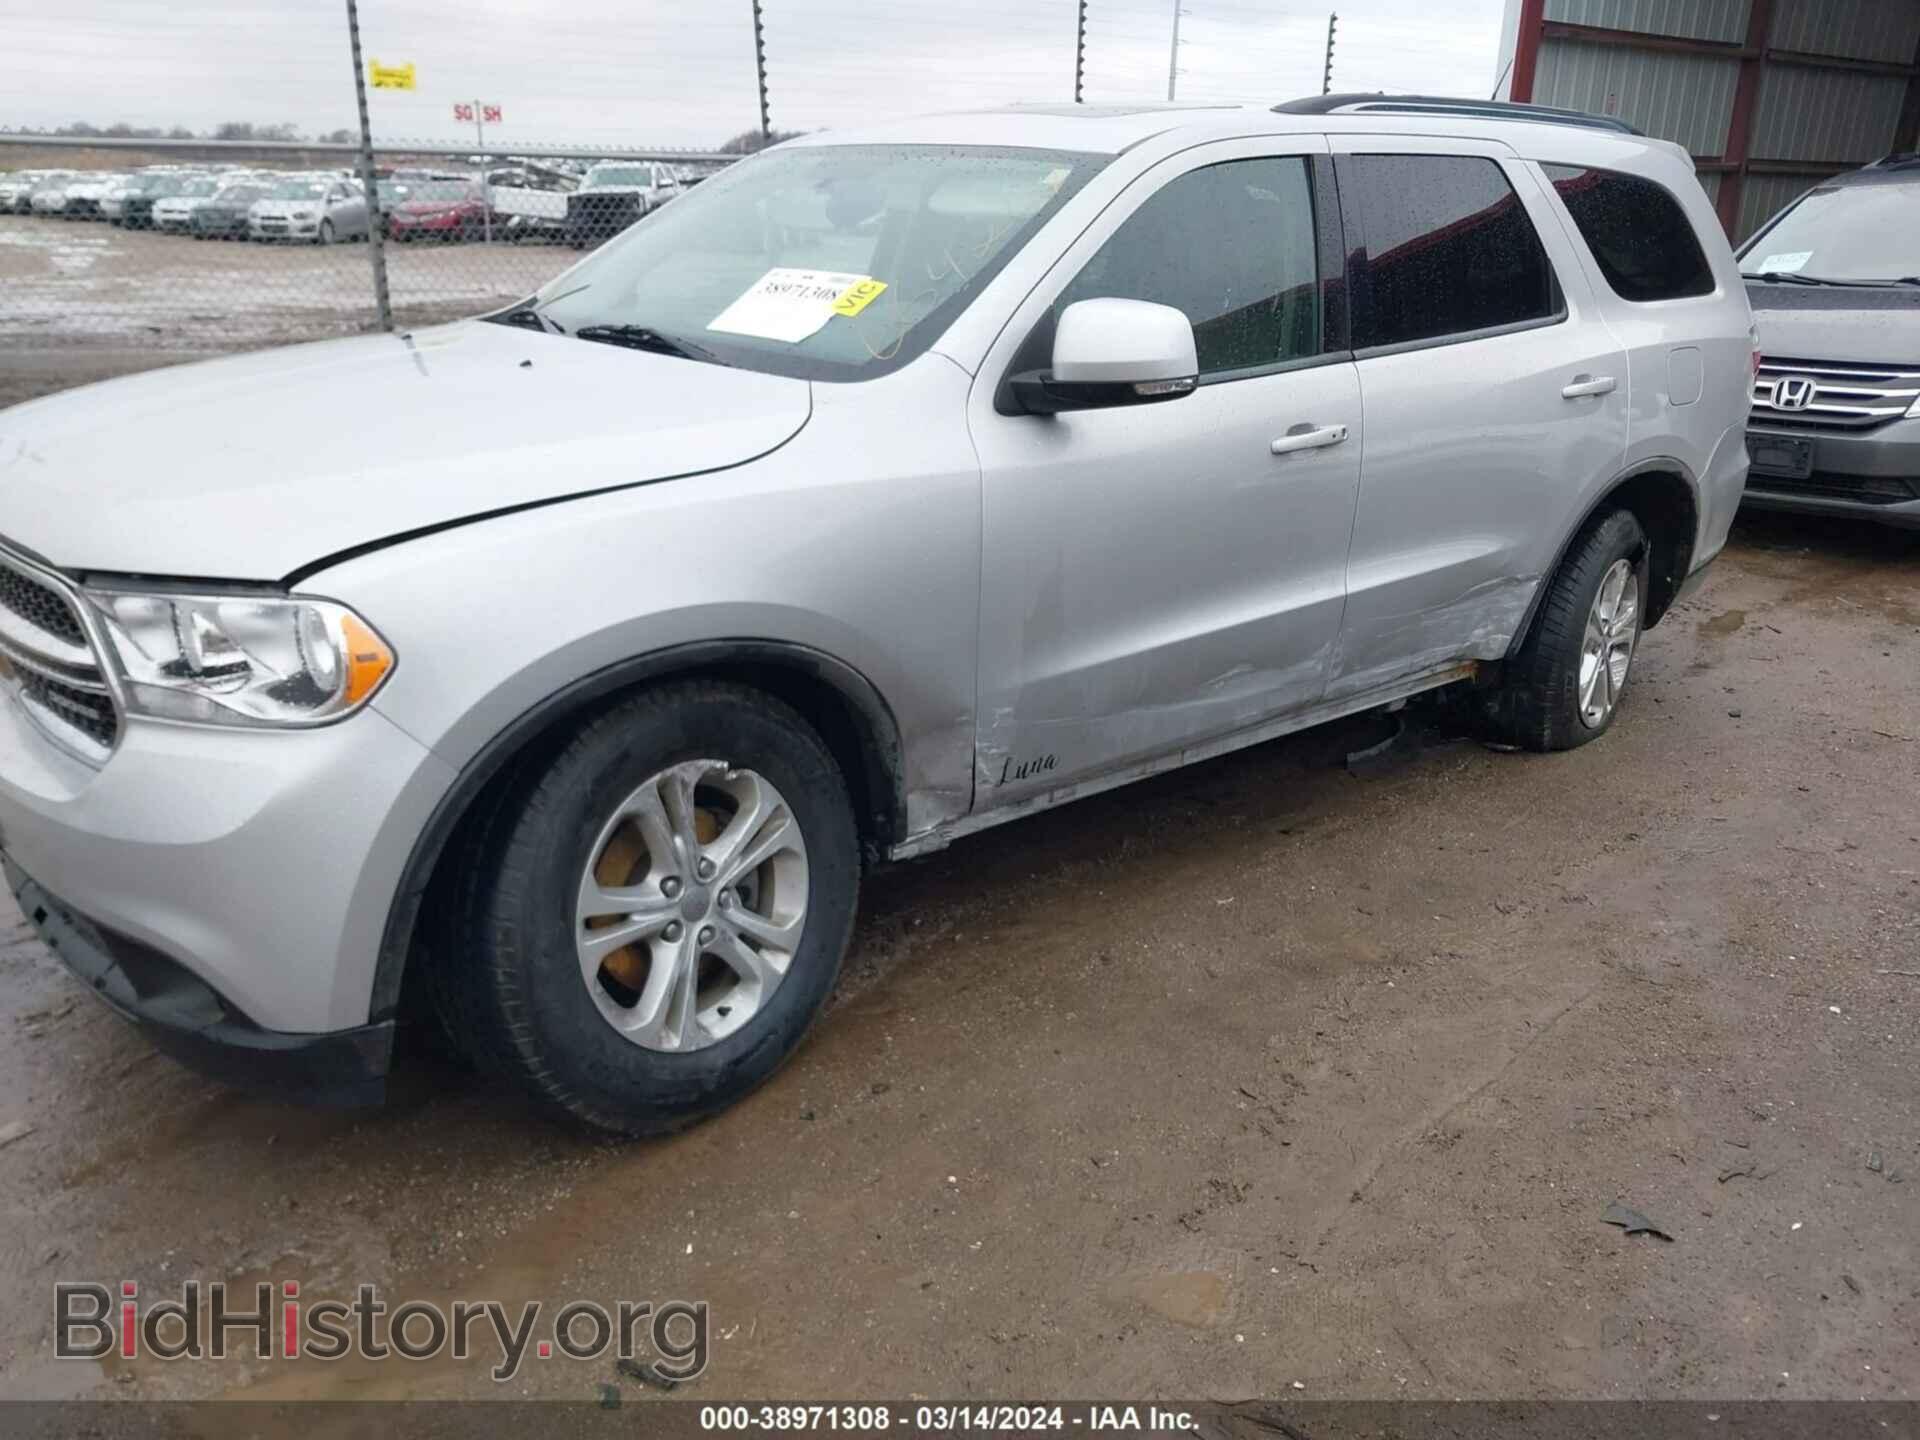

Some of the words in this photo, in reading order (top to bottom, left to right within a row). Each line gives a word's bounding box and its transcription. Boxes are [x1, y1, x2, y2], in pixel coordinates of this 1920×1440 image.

[483, 105, 503, 122] SH
[835, 282, 877, 310] VIC
[994, 754, 1057, 788] Luna
